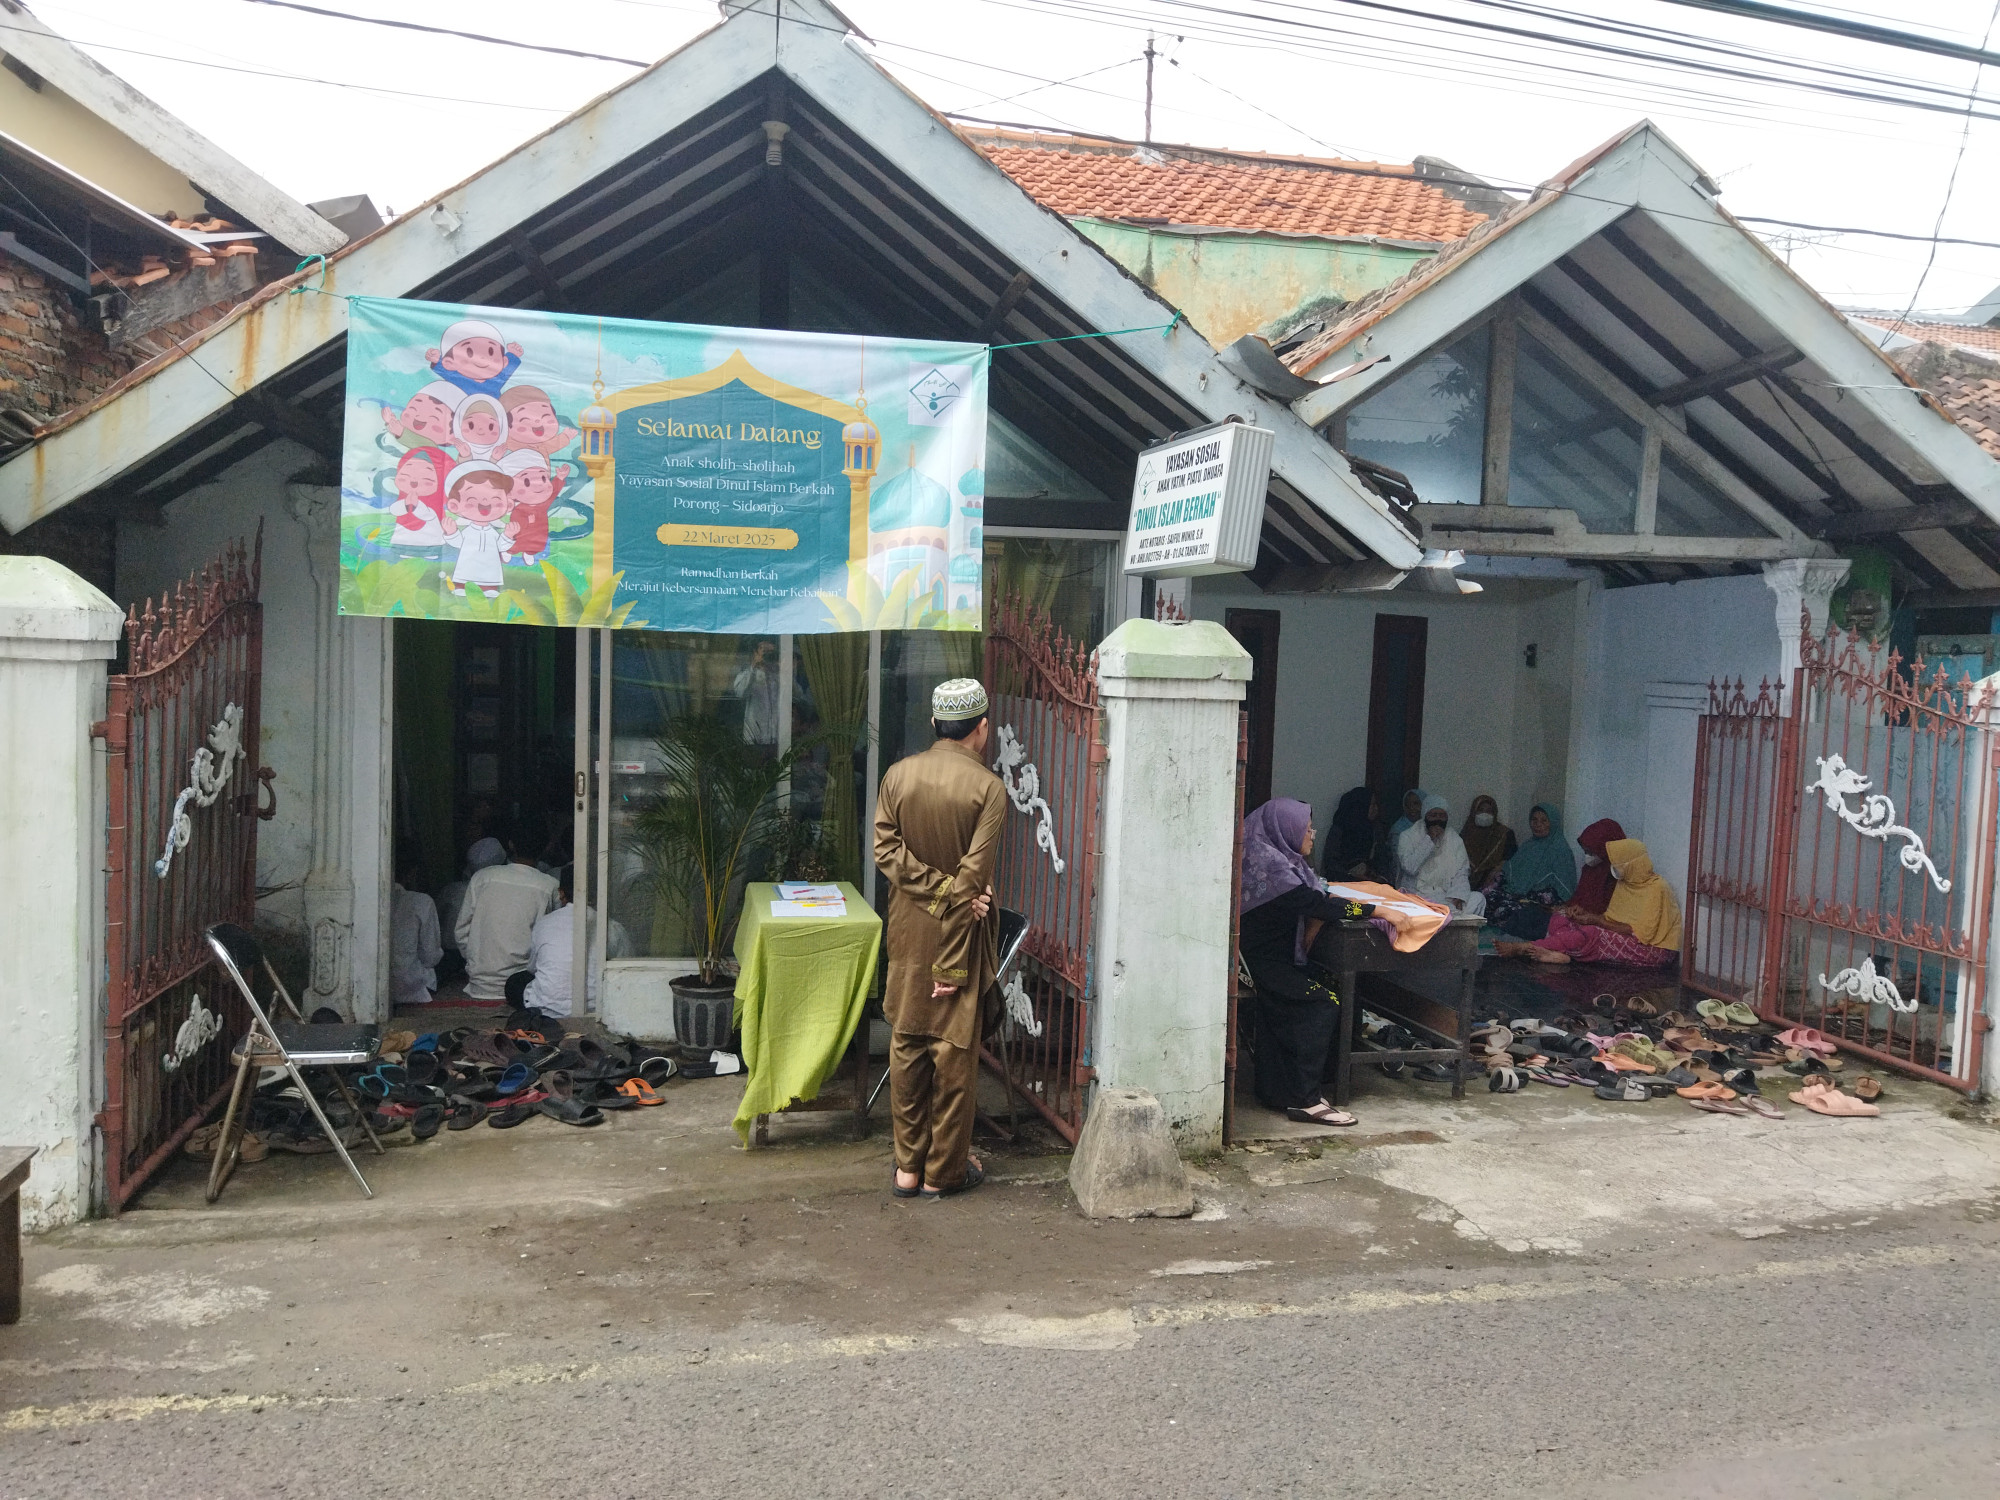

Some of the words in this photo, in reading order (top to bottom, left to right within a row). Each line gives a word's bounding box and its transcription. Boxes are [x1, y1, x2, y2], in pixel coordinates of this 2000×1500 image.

[637, 418, 733, 440] Selamat
[740, 422, 822, 450] Datang
[661, 455, 695, 468] Anak
[1166, 448, 1195, 474] YAYASAN
[1196, 441, 1220, 466] SOSIAL
[619, 474, 673, 488] Yayasan
[676, 476, 712, 489] Sosial
[716, 478, 750, 491] Dinul
[753, 480, 786, 493] Islam
[789, 482, 835, 496] Berkah
[1157, 478, 1170, 494] ANAK
[1203, 462, 1224, 482] DHUAFA
[673, 497, 720, 514] Porong
[732, 500, 784, 516] Sidoarjo
[1158, 500, 1183, 528] ISLAM
[683, 530, 698, 542] 22
[701, 532, 740, 544] Maret
[744, 534, 776, 546] 2025
[681, 566, 739, 579] Ramadhan
[741, 569, 779, 580] Berkah
[662, 582, 739, 596] Kebersamaan,
[741, 585, 789, 597] Menebar
